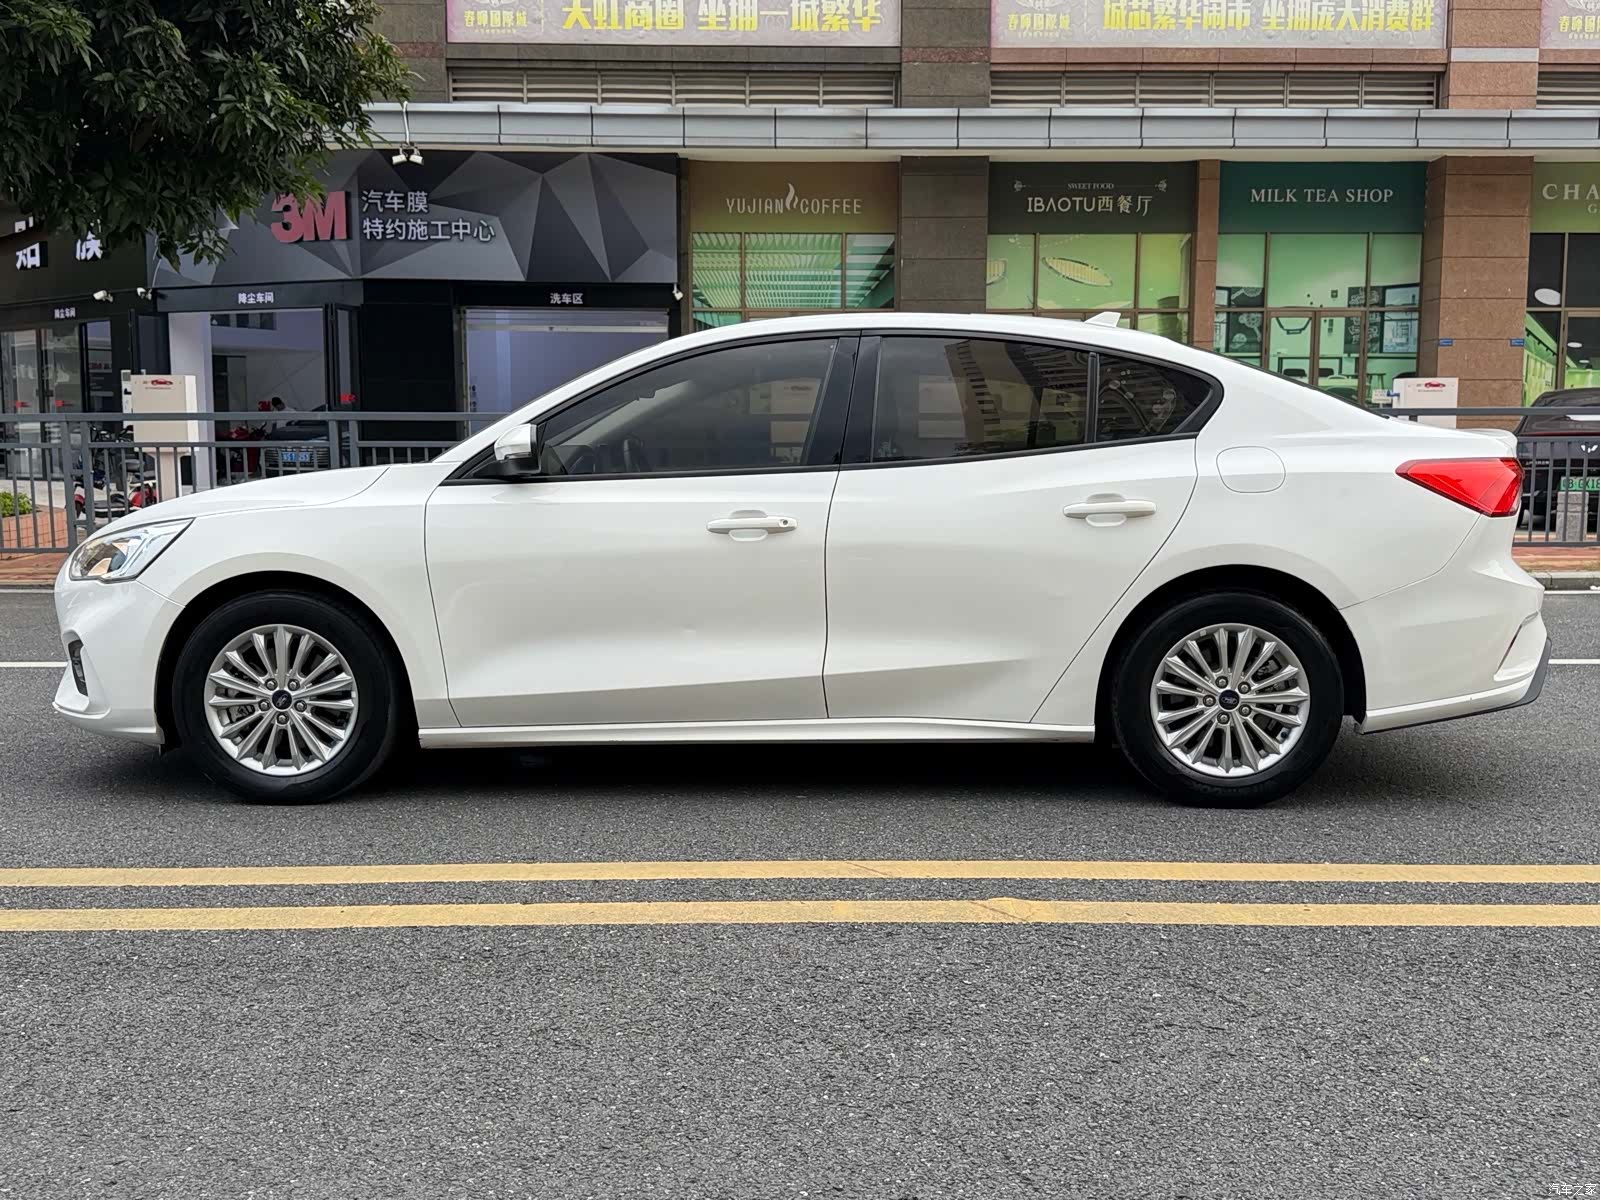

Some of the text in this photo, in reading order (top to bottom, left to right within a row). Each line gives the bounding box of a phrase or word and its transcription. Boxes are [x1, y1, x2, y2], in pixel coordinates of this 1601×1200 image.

[1067, 182, 1115, 190] SWEET FOOD
[362, 190, 429, 213] 汽车膜
[1250, 188, 1394, 203] MILK TEA SHOP
[726, 198, 862, 214] YUJIAN COFFEE
[271, 190, 348, 243] 3M
[362, 217, 496, 242] 特约施工中心
[237, 291, 274, 304] 降尘车间
[550, 292, 584, 304] 洗车区
